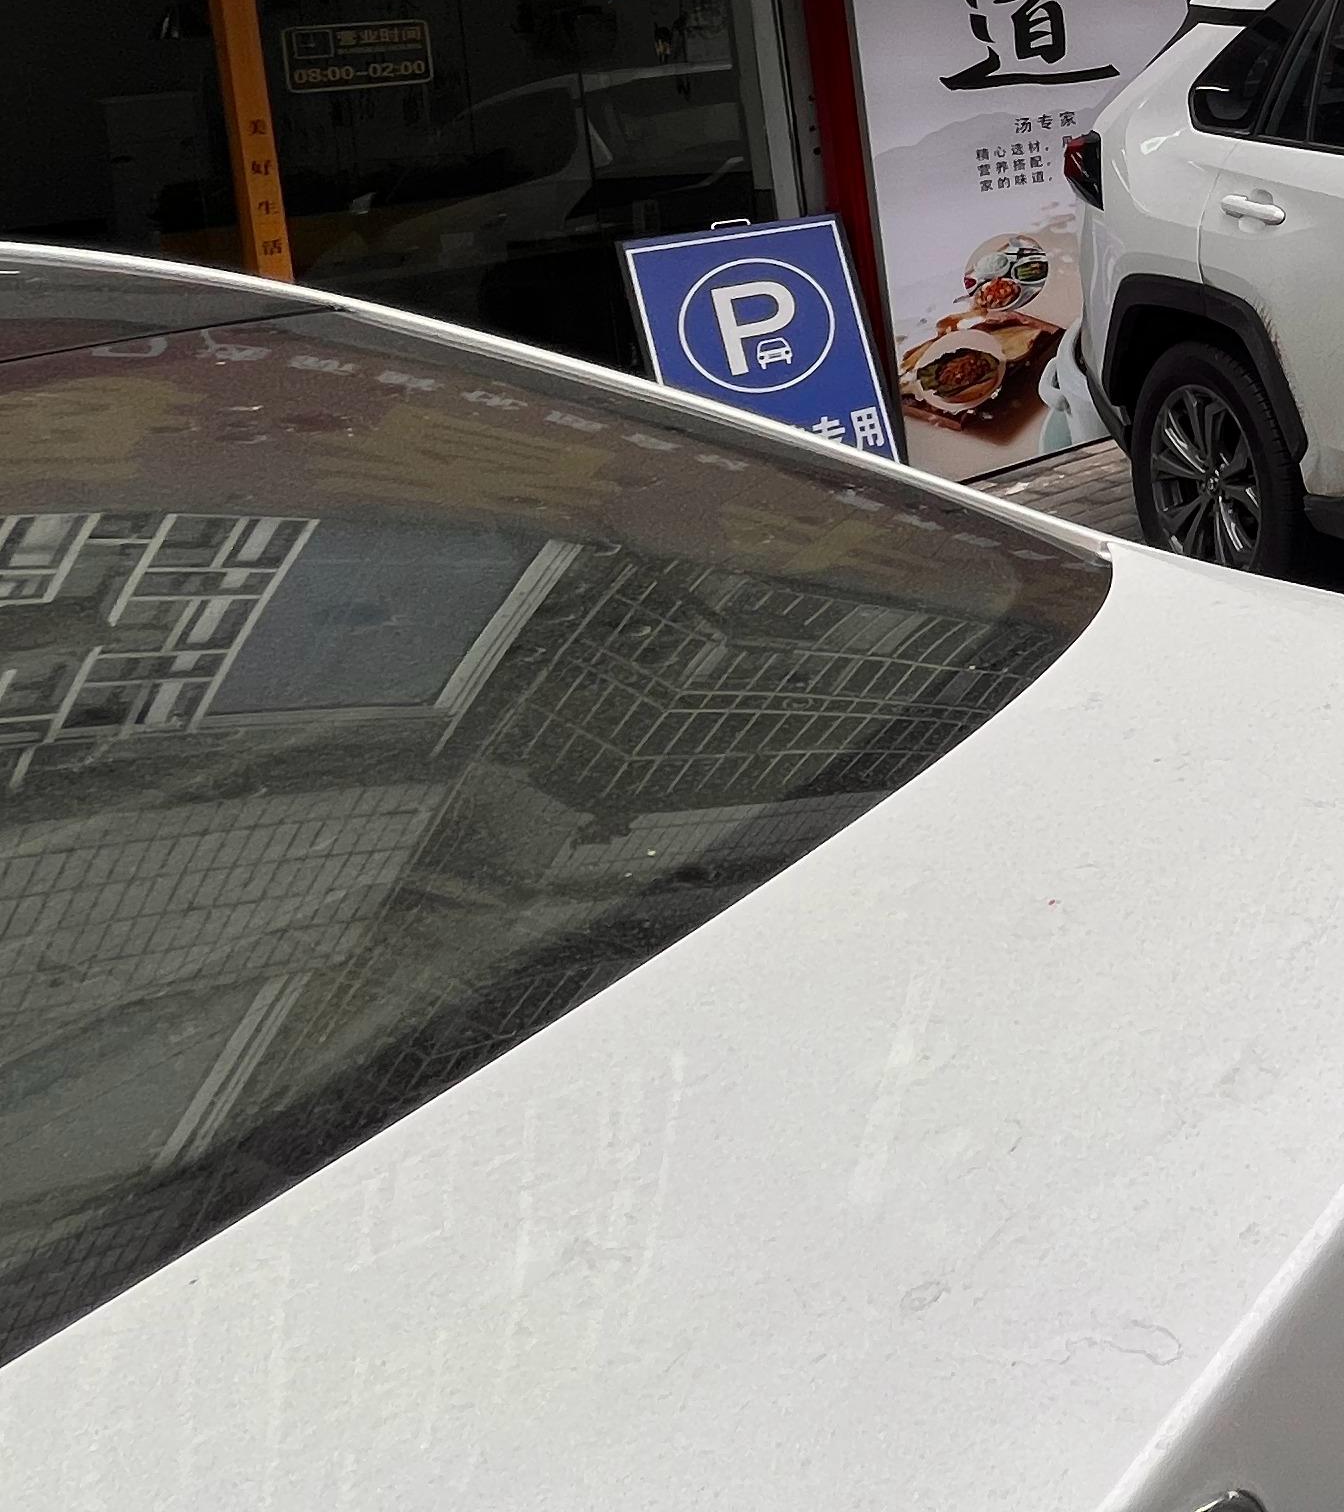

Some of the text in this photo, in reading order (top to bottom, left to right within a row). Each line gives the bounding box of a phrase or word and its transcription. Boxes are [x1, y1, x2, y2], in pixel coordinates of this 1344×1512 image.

[1014, 111, 1077, 134] 汤专家
[711, 280, 797, 376] P
[802, 406, 885, 449] 专用
